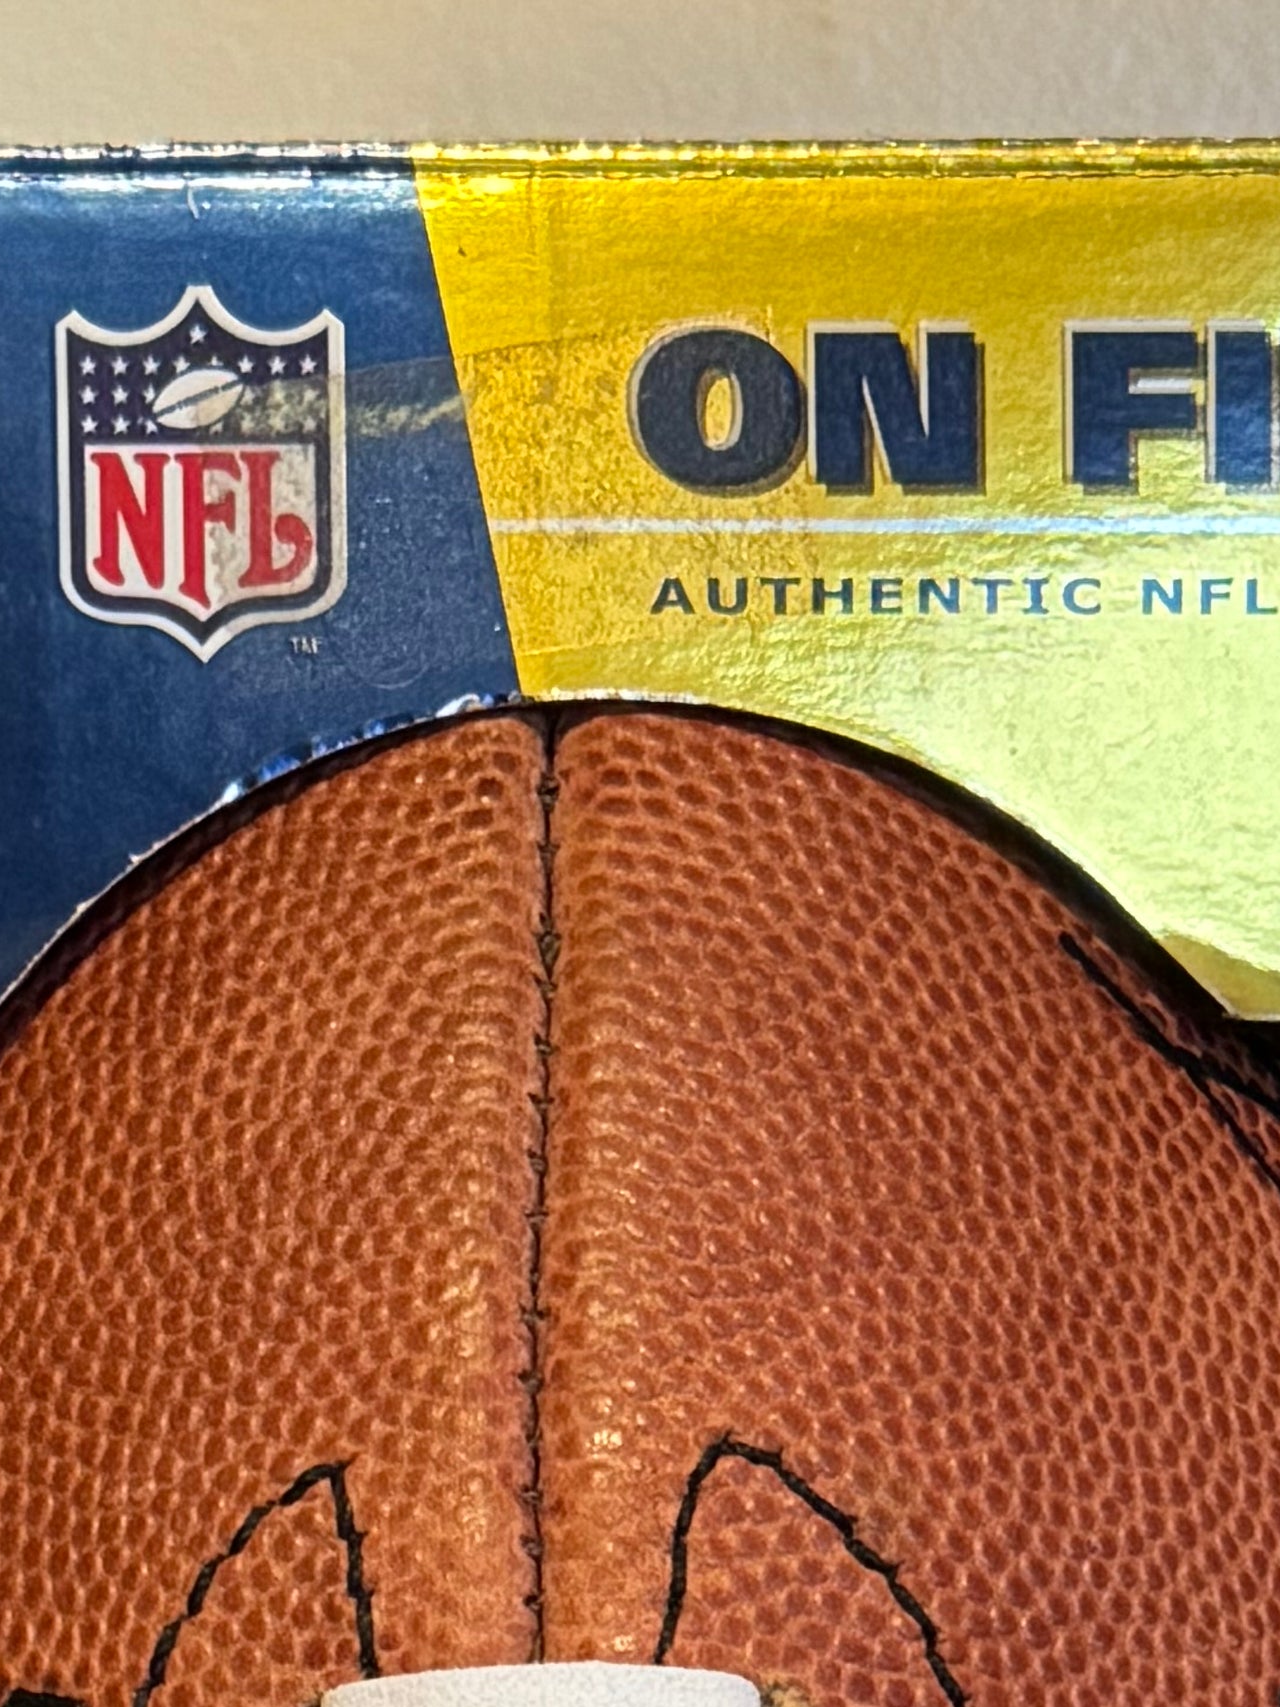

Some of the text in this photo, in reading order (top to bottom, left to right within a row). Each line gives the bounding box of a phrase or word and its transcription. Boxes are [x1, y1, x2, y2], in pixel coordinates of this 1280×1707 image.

[627, 318, 986, 495] ON
[91, 451, 313, 609] NFL
[649, 575, 1104, 616] AUTHENTIC
[1141, 576, 1279, 615] NFL
